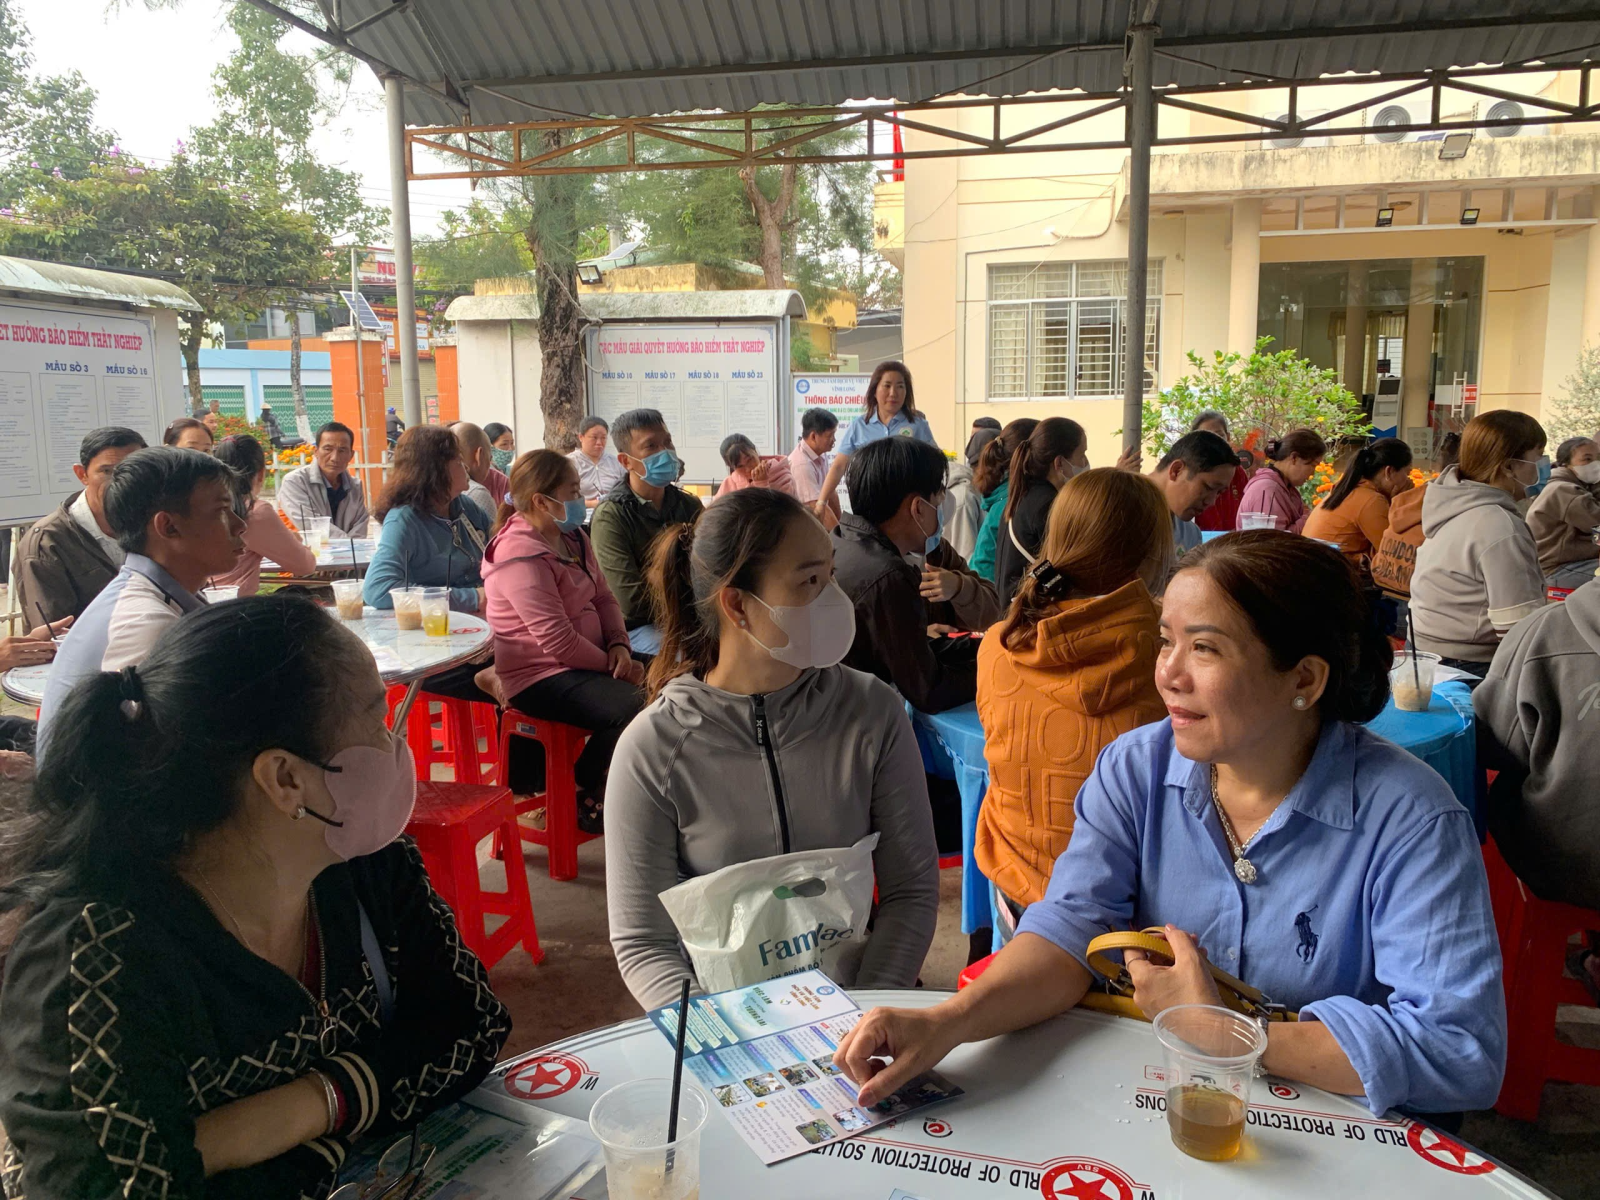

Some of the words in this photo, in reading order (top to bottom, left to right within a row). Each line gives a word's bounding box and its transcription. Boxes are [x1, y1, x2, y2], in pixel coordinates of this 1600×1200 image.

[47, 322, 66, 345] BẢO
[67, 322, 90, 347] HIỂM
[113, 332, 142, 354] NGHIỆP
[690, 337, 703, 353] BẢO
[83, 364, 89, 373] 3
[804, 394, 827, 405] THÔNG
[829, 394, 843, 405] BÁO
[1246, 1109, 1335, 1136] PROTECTIO
[1343, 1124, 1365, 1140] OF
[871, 1146, 971, 1178] PROTECTION
[1077, 1163, 1100, 1173] SBV
[978, 1164, 1000, 1184] OF
